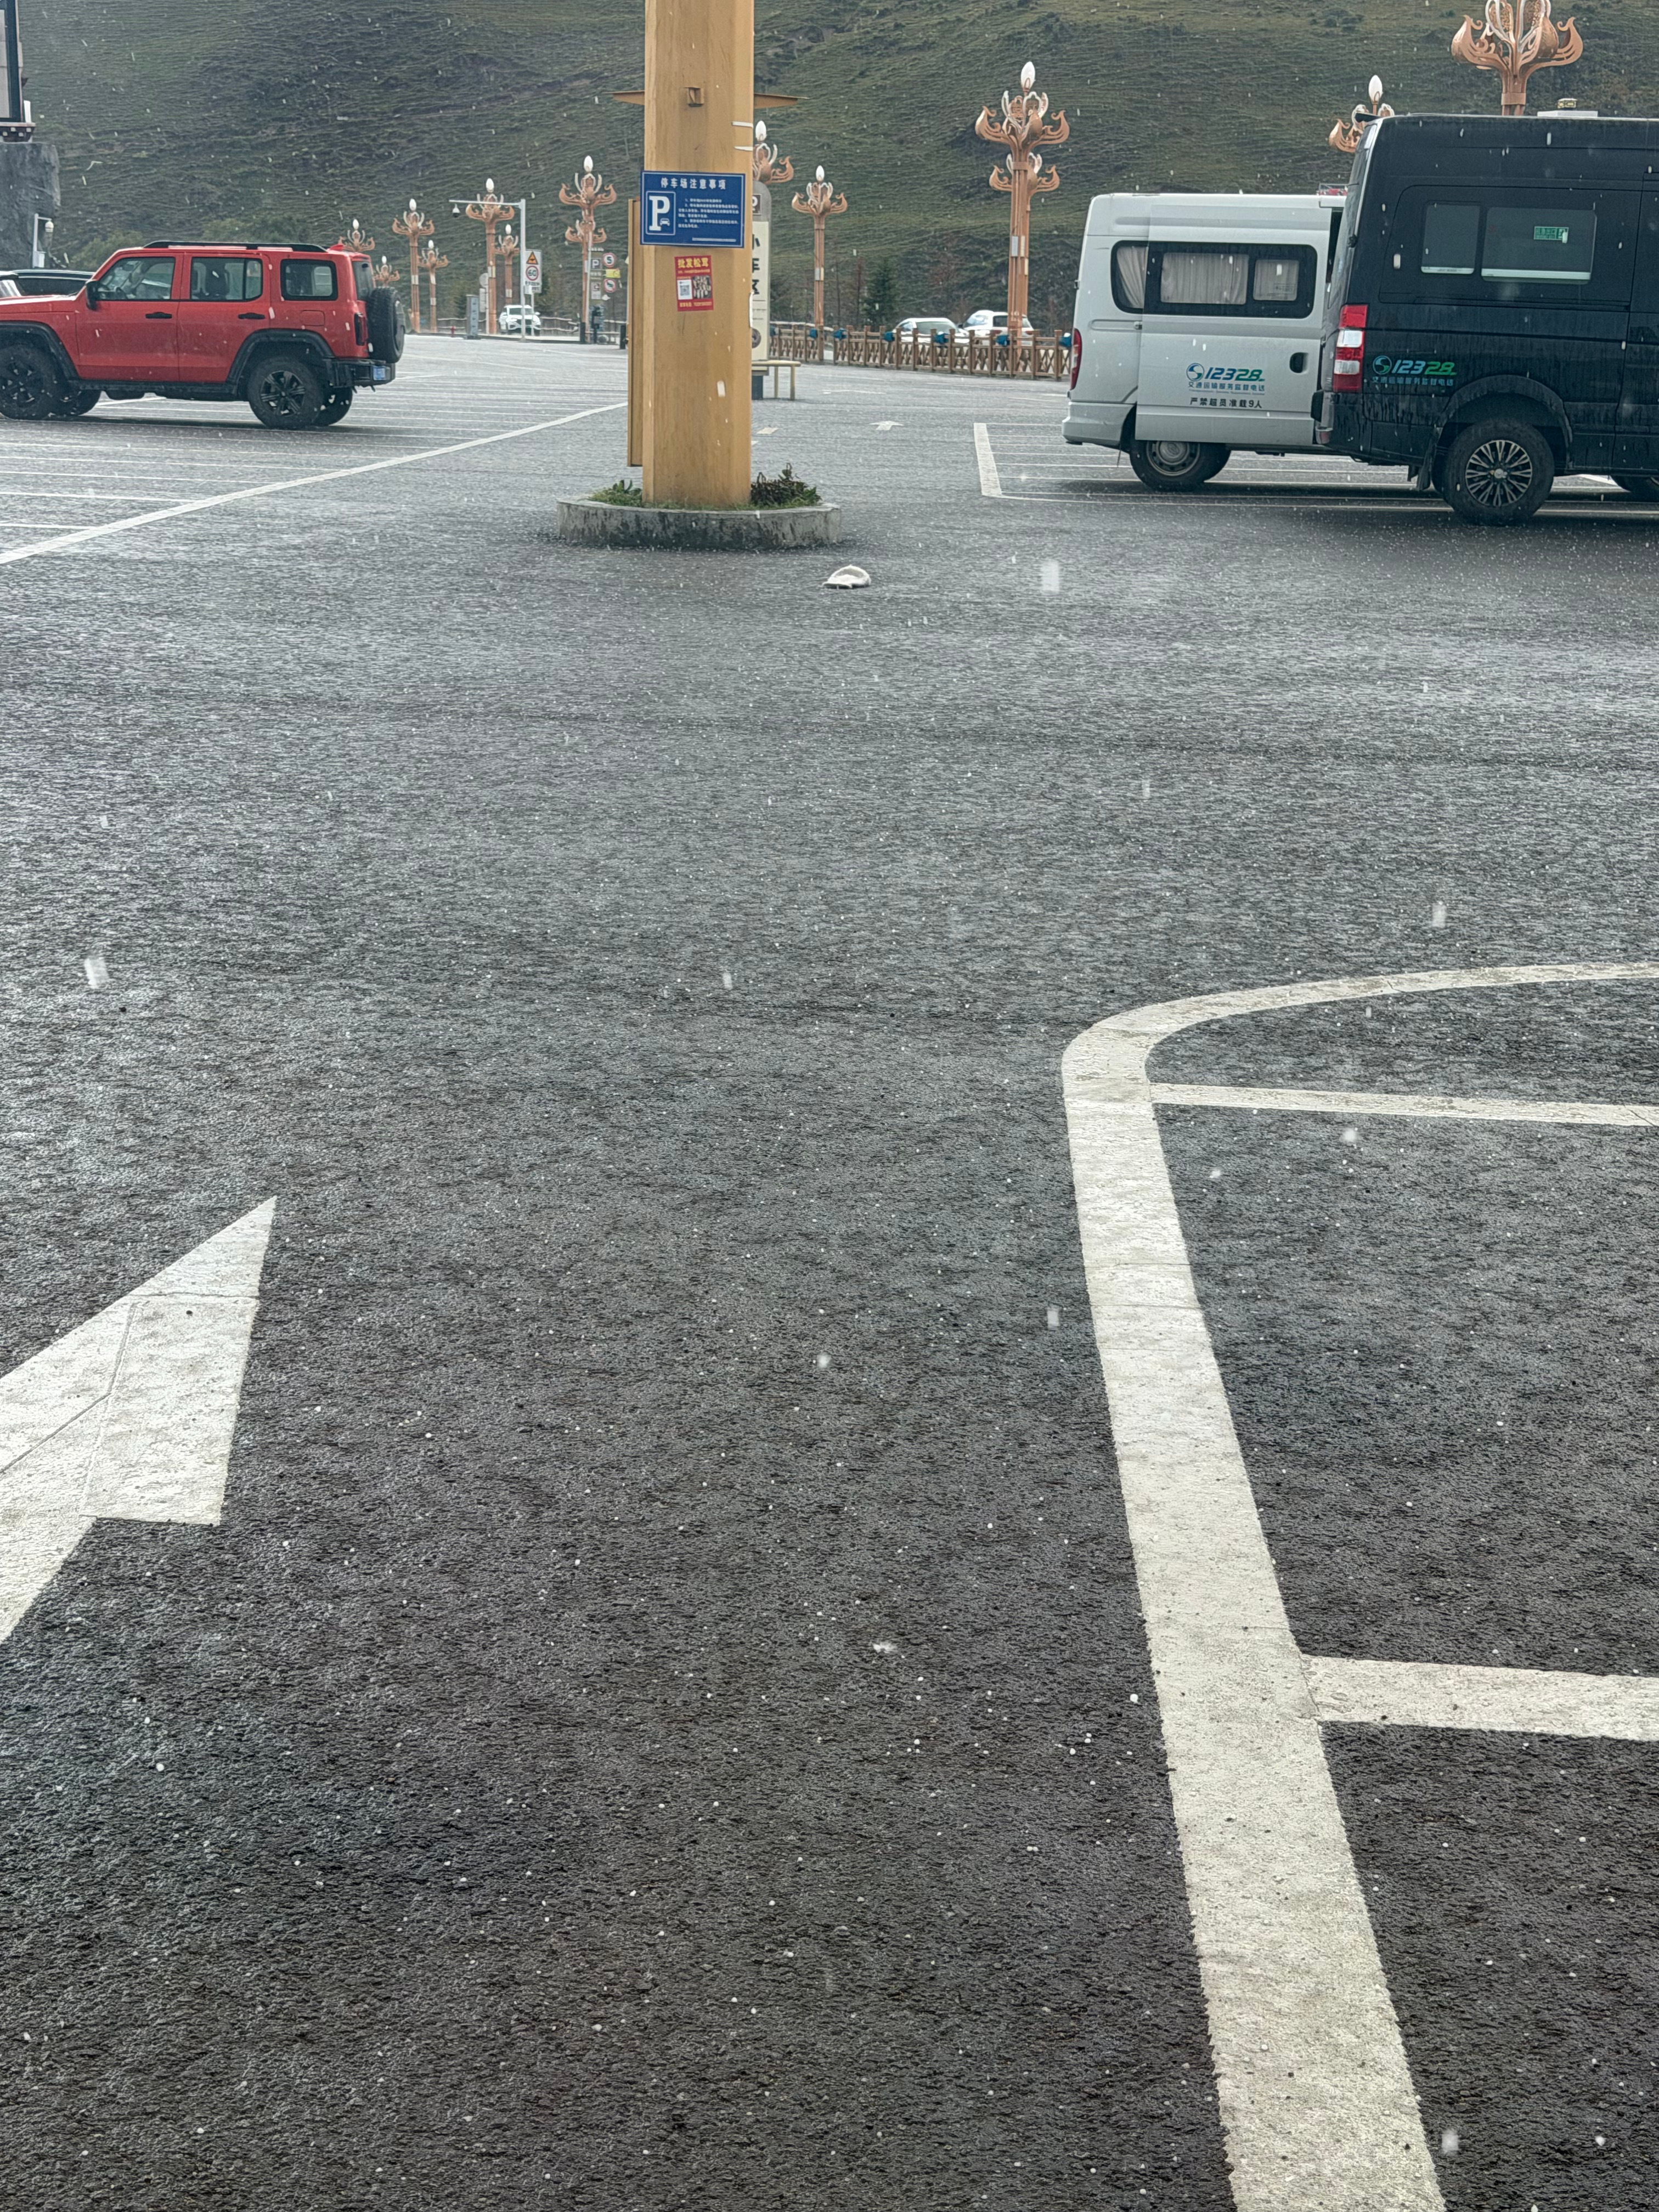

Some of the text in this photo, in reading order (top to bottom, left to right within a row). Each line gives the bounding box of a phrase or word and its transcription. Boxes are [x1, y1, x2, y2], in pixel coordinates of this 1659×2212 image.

[661, 177, 726, 190] 停车场注意事项
[649, 195, 670, 231] P
[592, 259, 599, 268] P
[1391, 359, 1457, 376] 12328
[1205, 367, 1265, 382] 12328
[1188, 382, 1265, 392] 交通运输服务监督电话
[1190, 397, 1262, 408] 严禁超员准载9人
